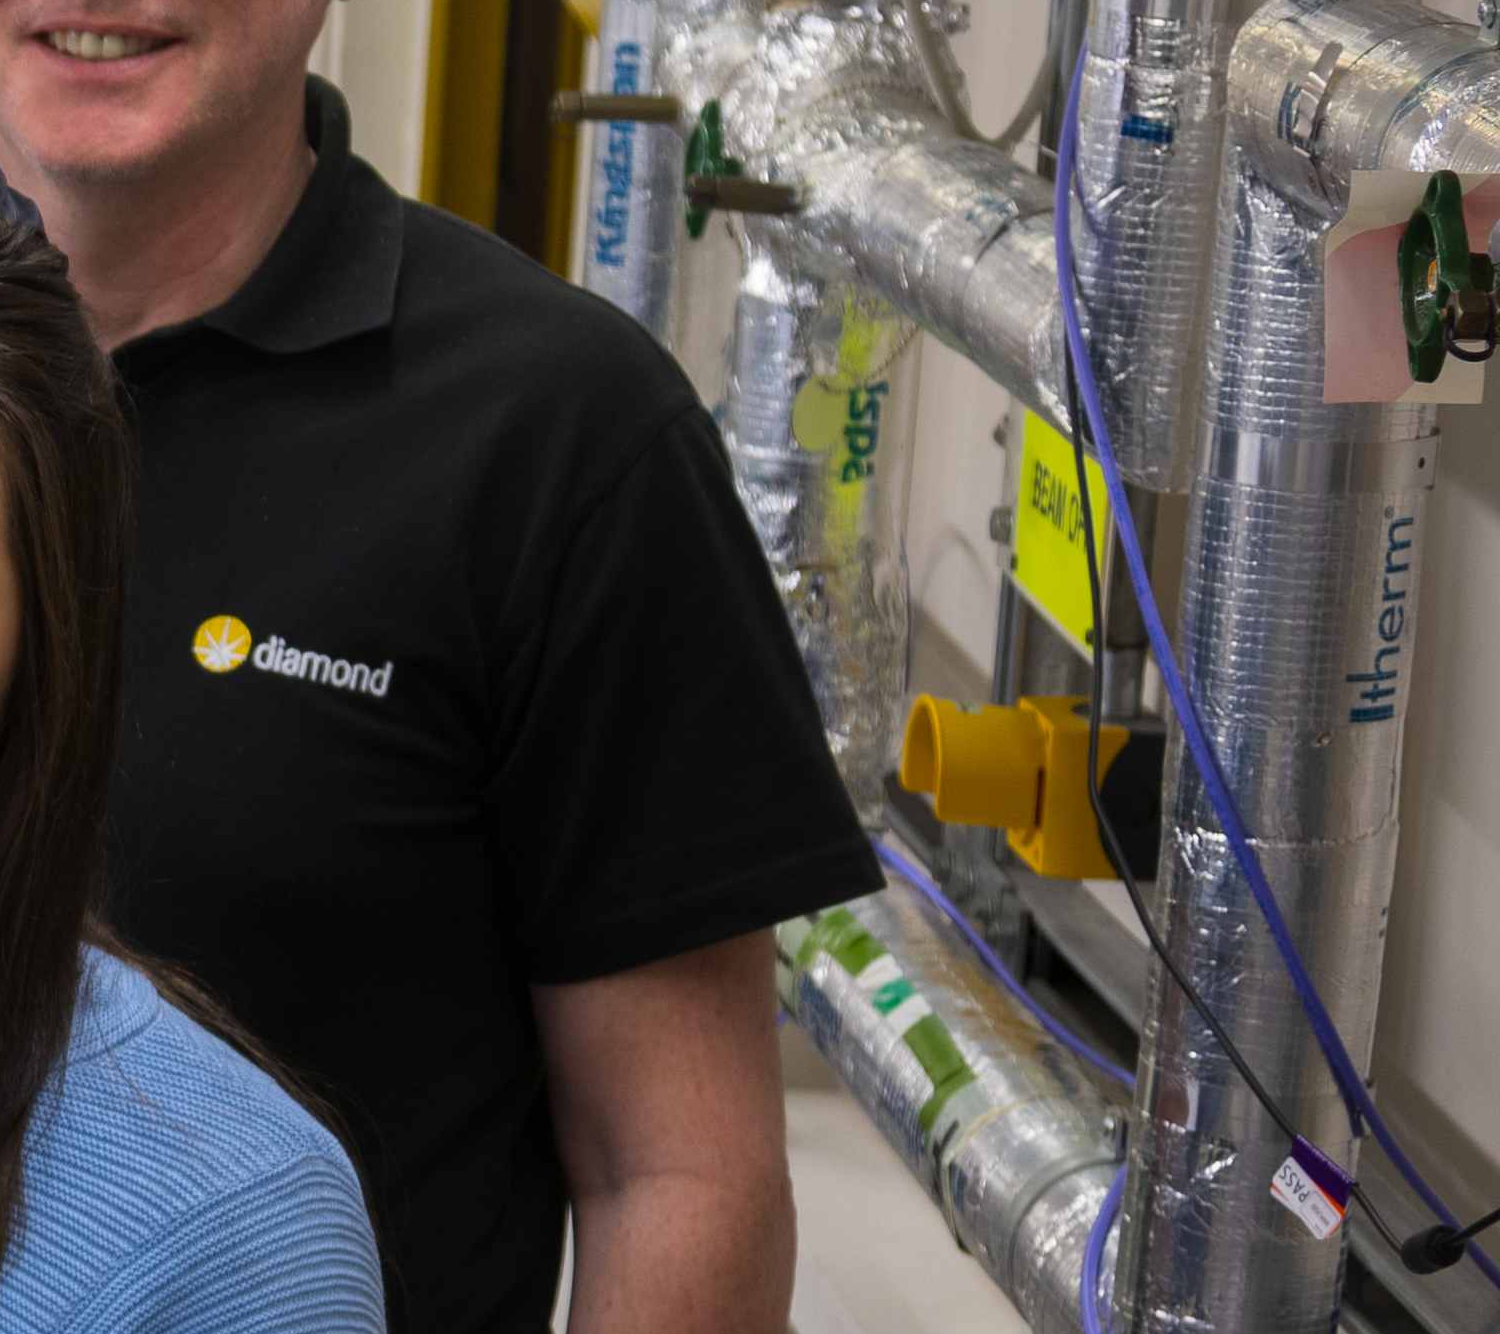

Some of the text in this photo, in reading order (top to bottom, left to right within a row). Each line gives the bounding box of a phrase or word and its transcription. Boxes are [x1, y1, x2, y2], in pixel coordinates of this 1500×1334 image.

[1031, 459, 1067, 533] BEAM
[252, 634, 394, 698] diamond
[1278, 1164, 1311, 1204] PASS
